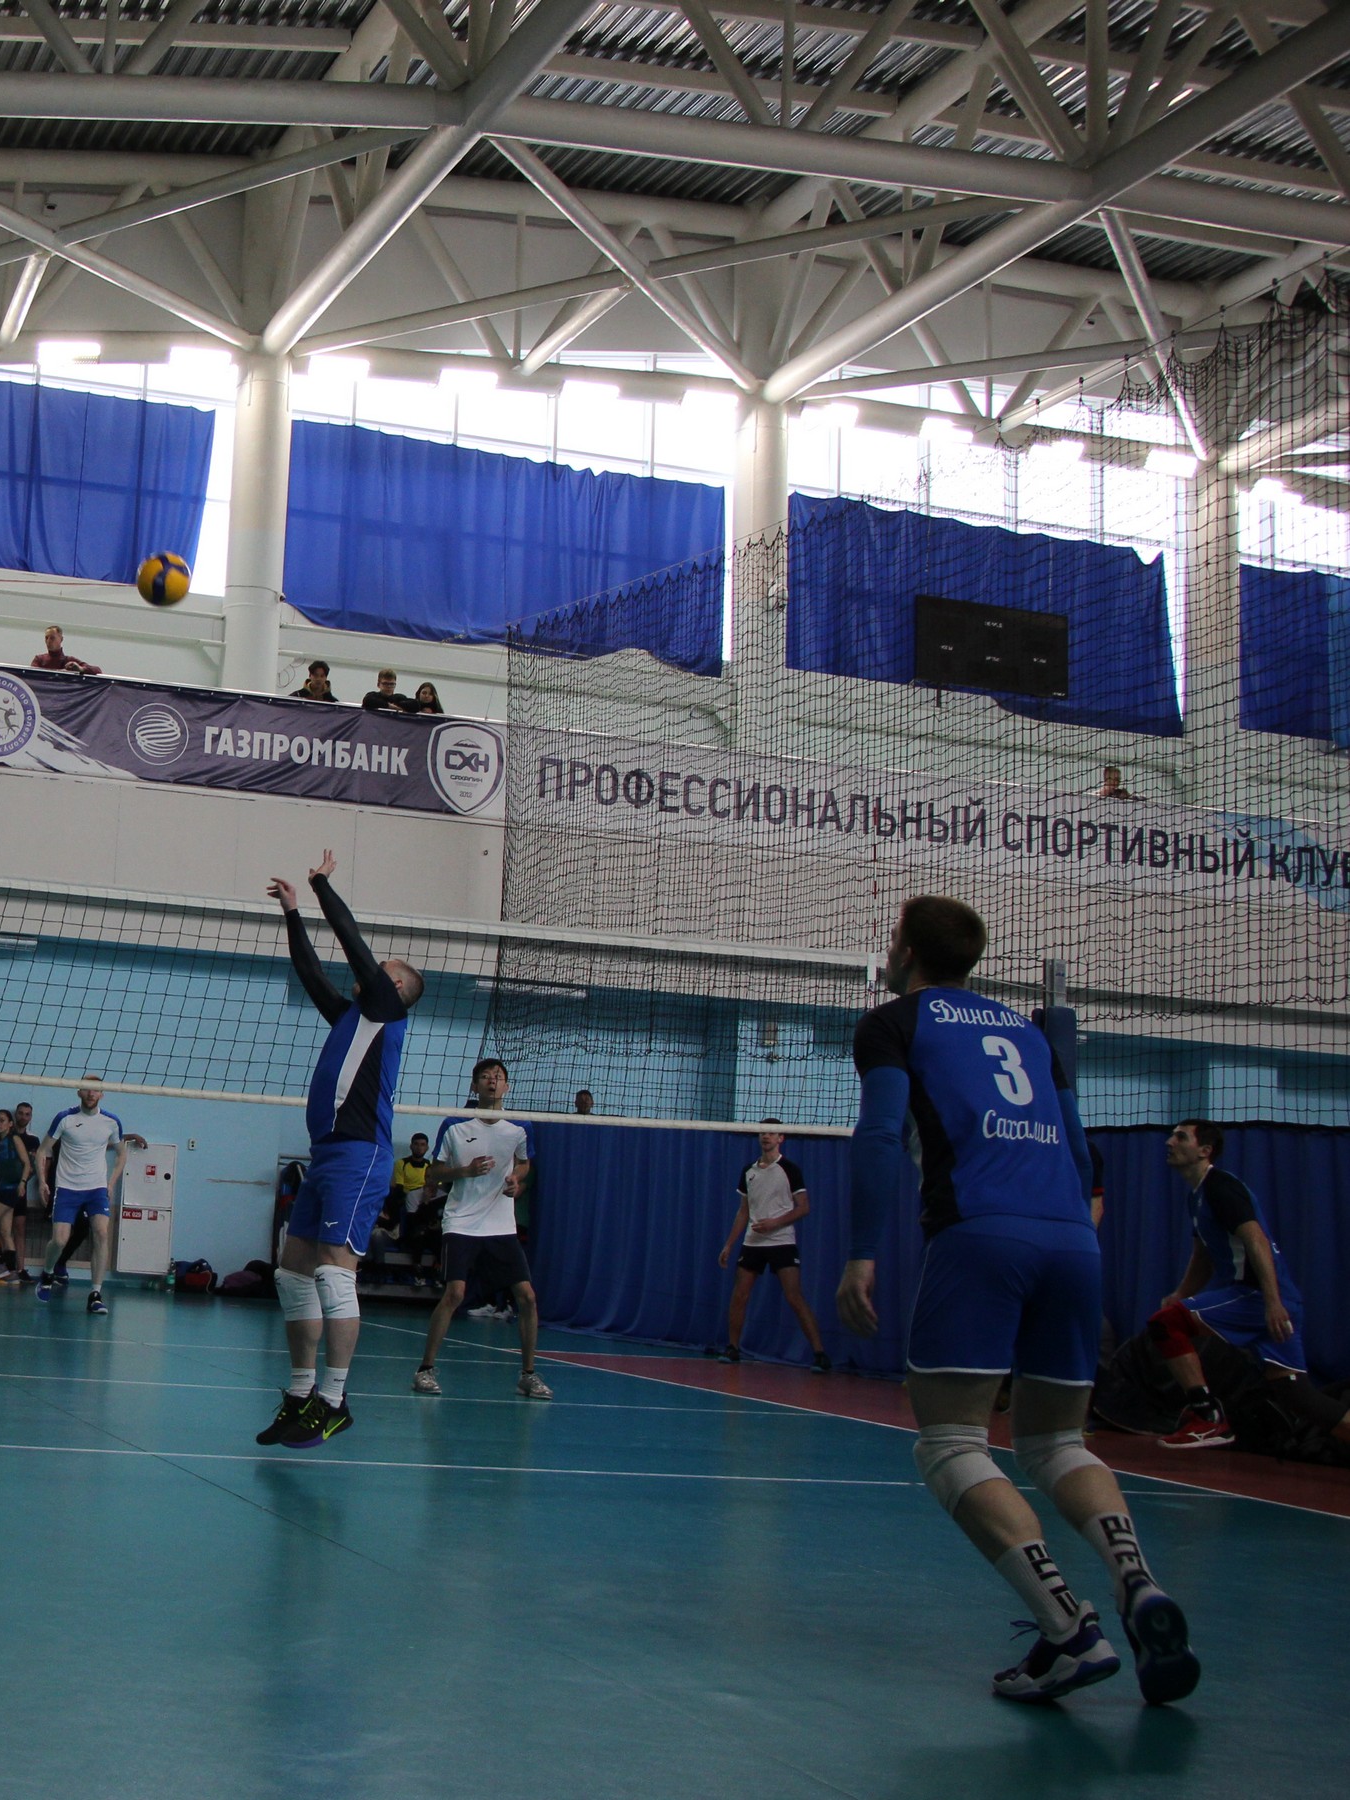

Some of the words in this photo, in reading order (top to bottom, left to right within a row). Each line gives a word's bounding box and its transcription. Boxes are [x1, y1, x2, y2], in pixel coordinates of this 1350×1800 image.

[19, 693, 29, 705] по
[204, 725, 409, 776] ГАЗПРОМБАНК
[537, 756, 986, 848] ПРОФЕССИОНАЛЬНЫЙ
[1001, 811, 1255, 878] СПОРТИВНЫЙ
[928, 999, 1025, 1028] Динамо
[982, 1035, 1033, 1106] 3
[982, 1109, 1059, 1144] Сахалин
